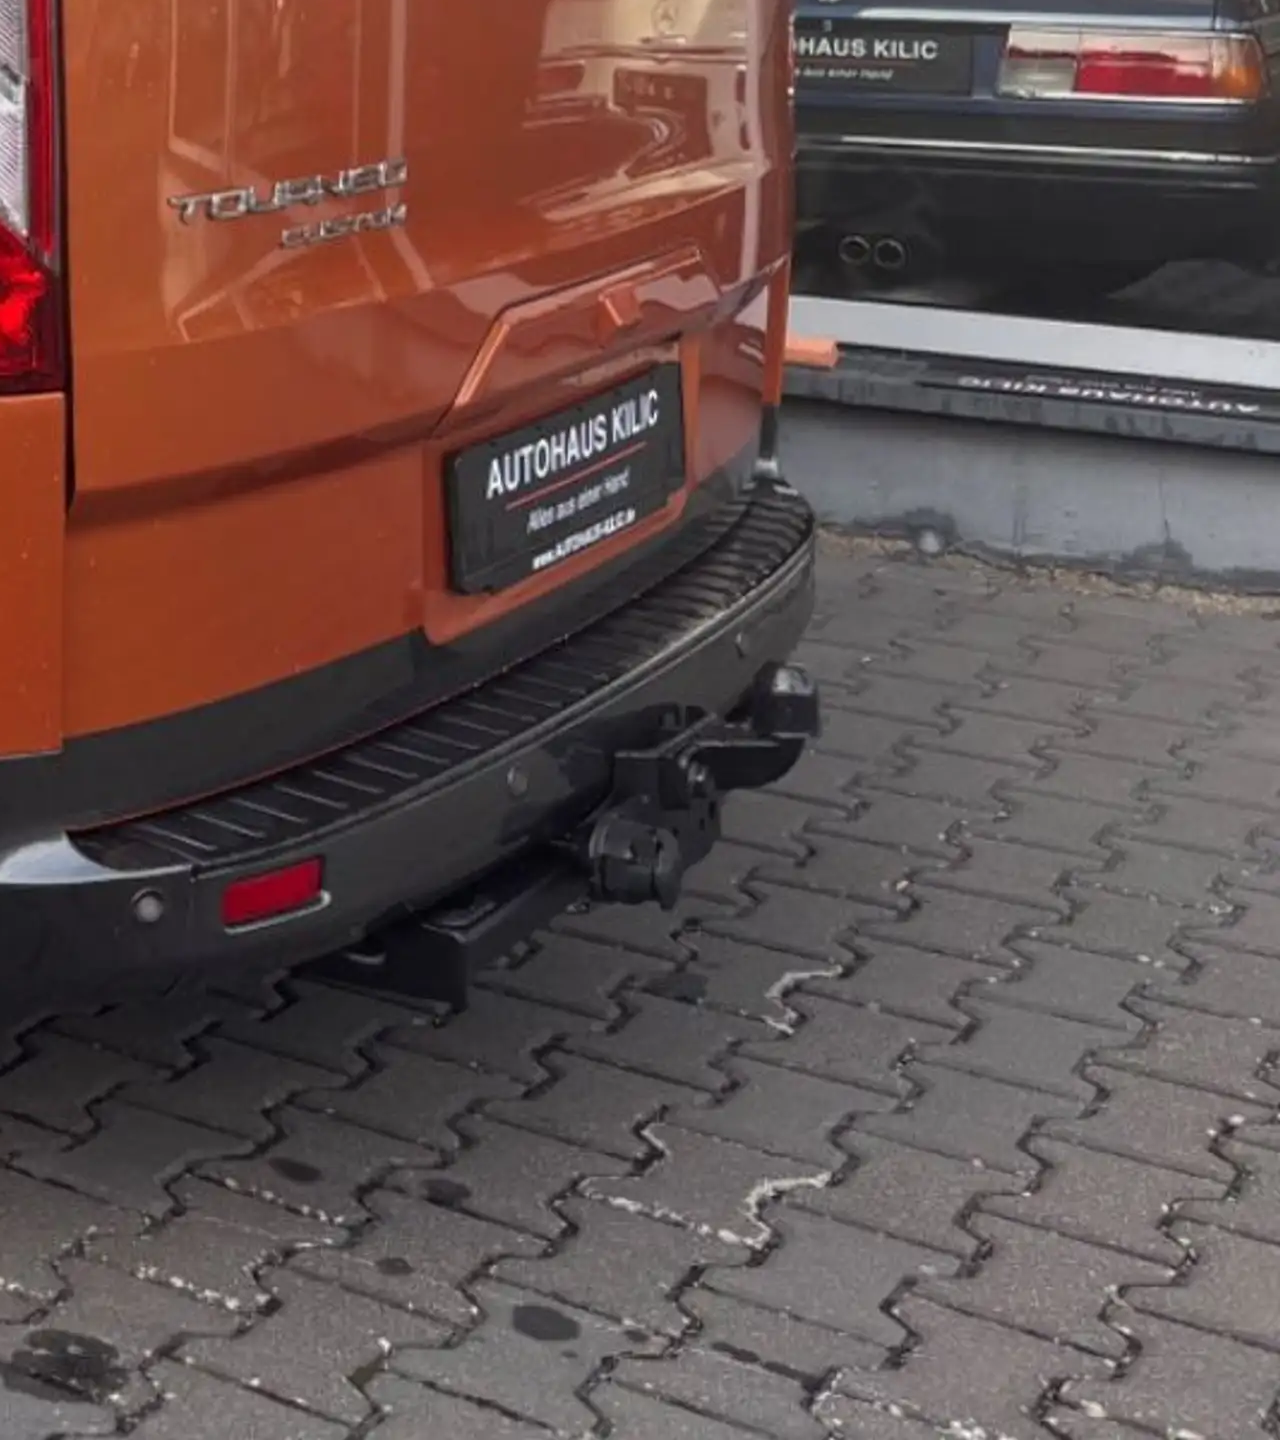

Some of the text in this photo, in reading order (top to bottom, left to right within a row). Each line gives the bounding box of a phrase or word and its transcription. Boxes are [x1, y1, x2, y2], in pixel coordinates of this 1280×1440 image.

[793, 36, 939, 60] HAUS KILIC
[485, 388, 659, 501] AUTOHAUS KILIC
